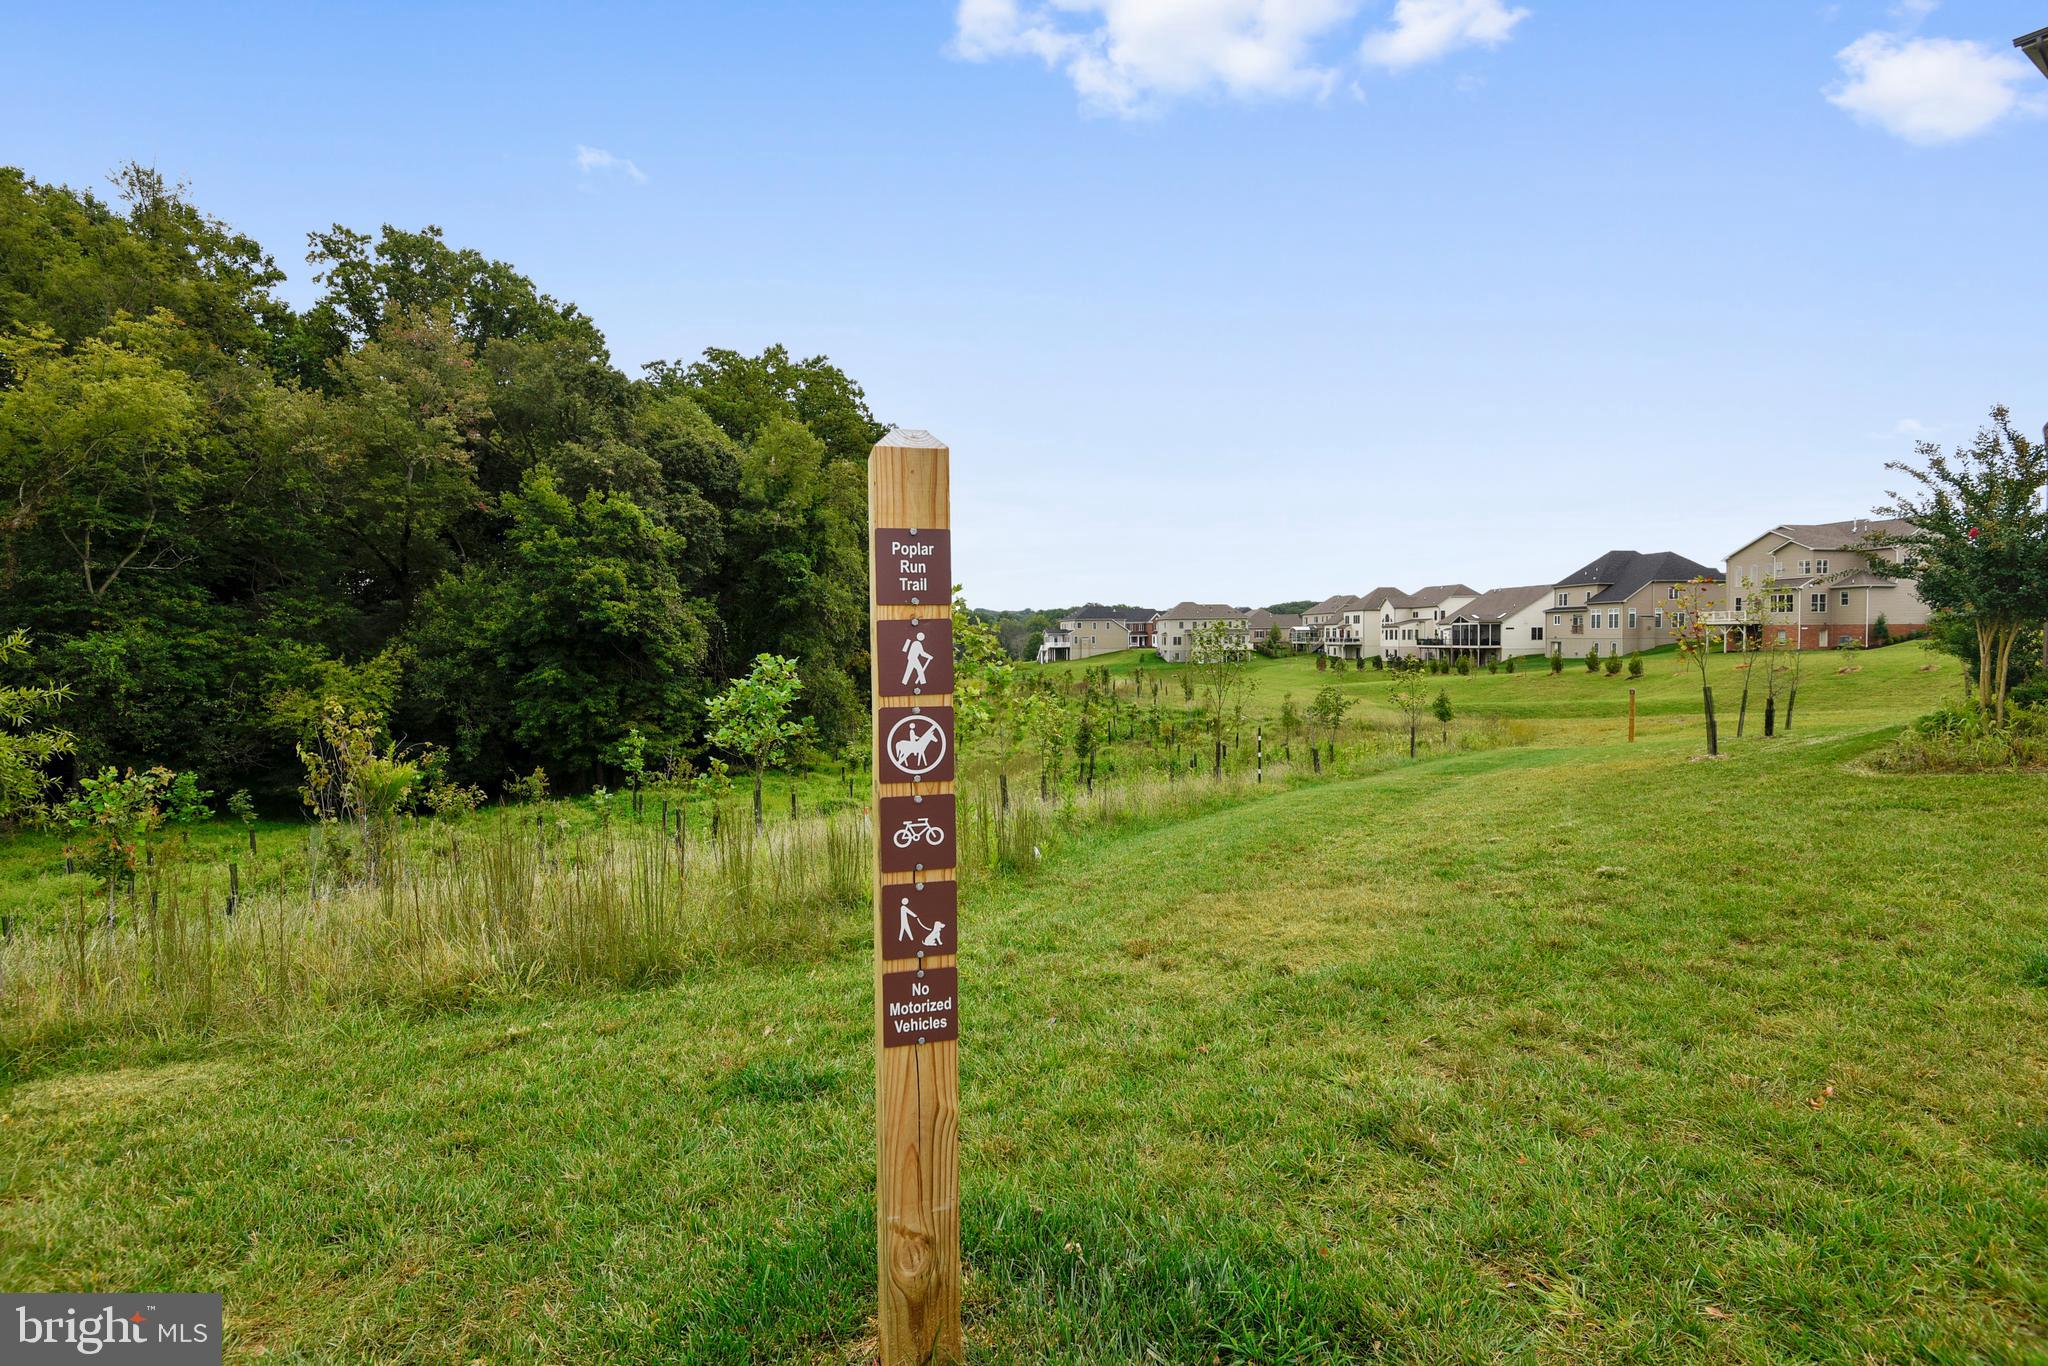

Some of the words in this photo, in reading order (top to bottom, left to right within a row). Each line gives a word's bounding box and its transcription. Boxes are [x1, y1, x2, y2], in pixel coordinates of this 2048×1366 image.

[891, 541, 934, 558] Poplar
[900, 560, 926, 573] Run
[899, 577, 927, 591] Trail
[912, 982, 930, 997] No
[889, 996, 952, 1016] Motorized
[894, 1016, 948, 1033] Vehicles
